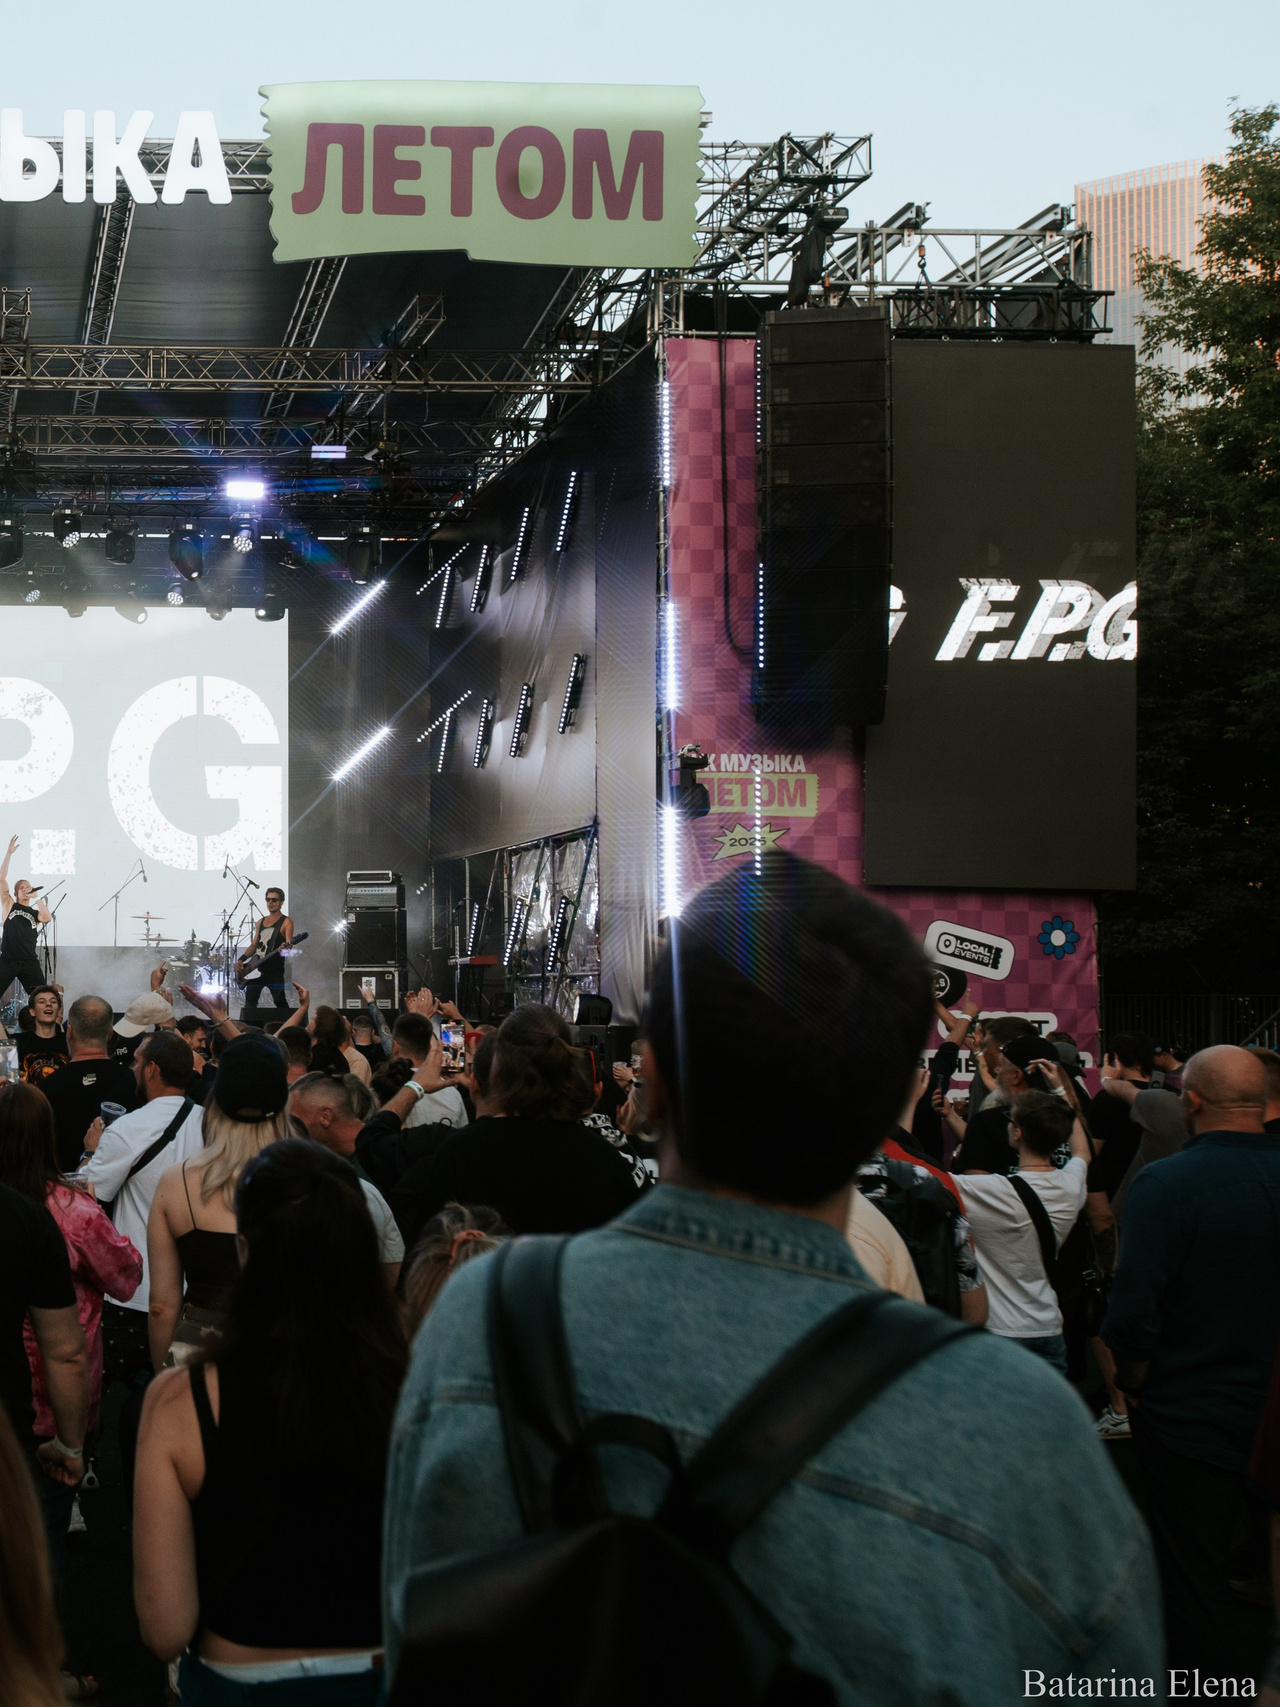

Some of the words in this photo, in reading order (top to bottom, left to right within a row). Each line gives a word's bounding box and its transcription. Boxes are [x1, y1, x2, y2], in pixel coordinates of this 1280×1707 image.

[291, 122, 664, 222] ЛЕТОМ
[720, 753, 807, 773] МУЗЫКА
[954, 948, 990, 964] EVENTS
[956, 940, 991, 956] LOCAL
